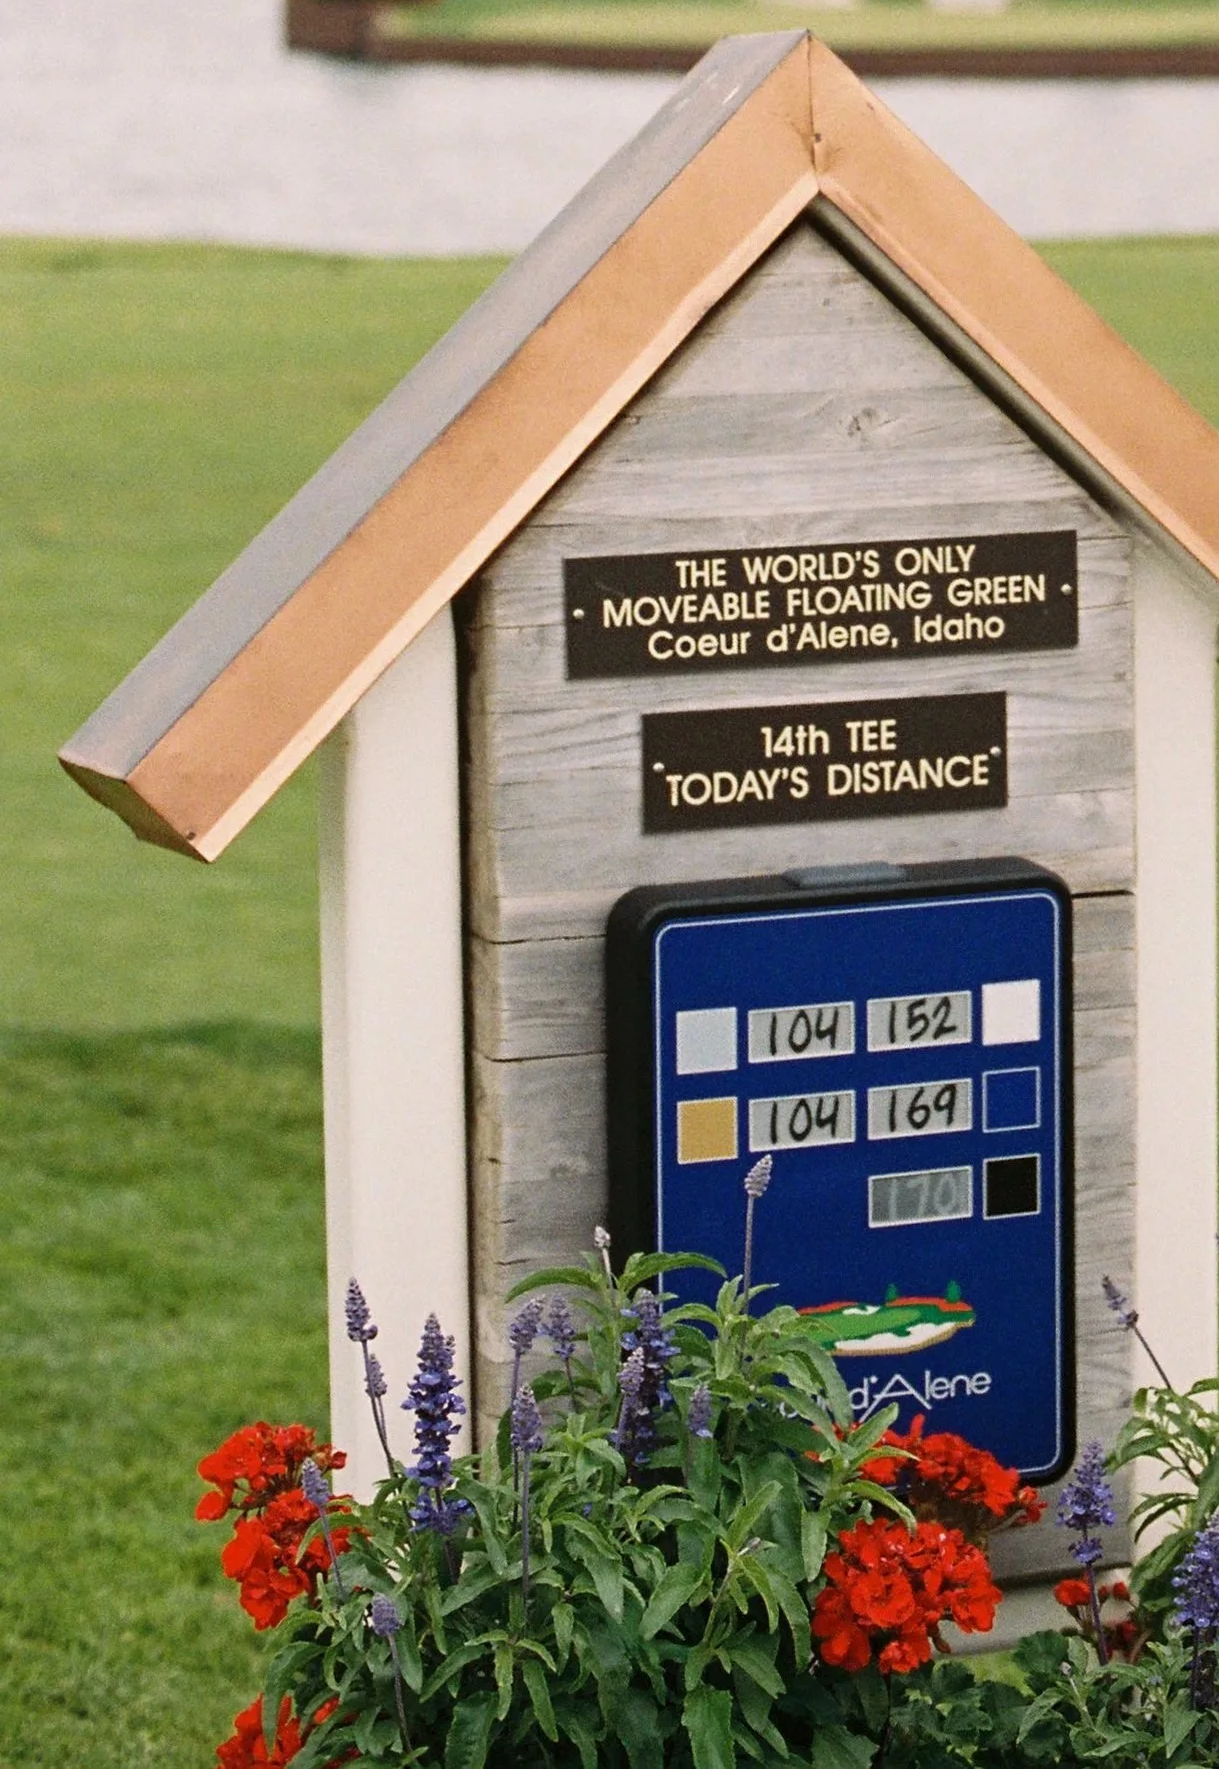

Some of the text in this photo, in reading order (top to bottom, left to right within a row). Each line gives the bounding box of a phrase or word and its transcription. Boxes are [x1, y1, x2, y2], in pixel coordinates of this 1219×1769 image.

[675, 545, 976, 588] THE WORLD'S ONLY
[603, 574, 1046, 628] MOVEABLE FLOATING GREEN
[649, 614, 1005, 660] Coeur d'Alene, Idaho
[761, 719, 897, 759] 14th TEE
[666, 754, 989, 807] TODAY'S DISTANCE
[769, 996, 957, 1056] 104 152
[770, 1083, 957, 1145] 104 169
[889, 1172, 957, 1222] 170
